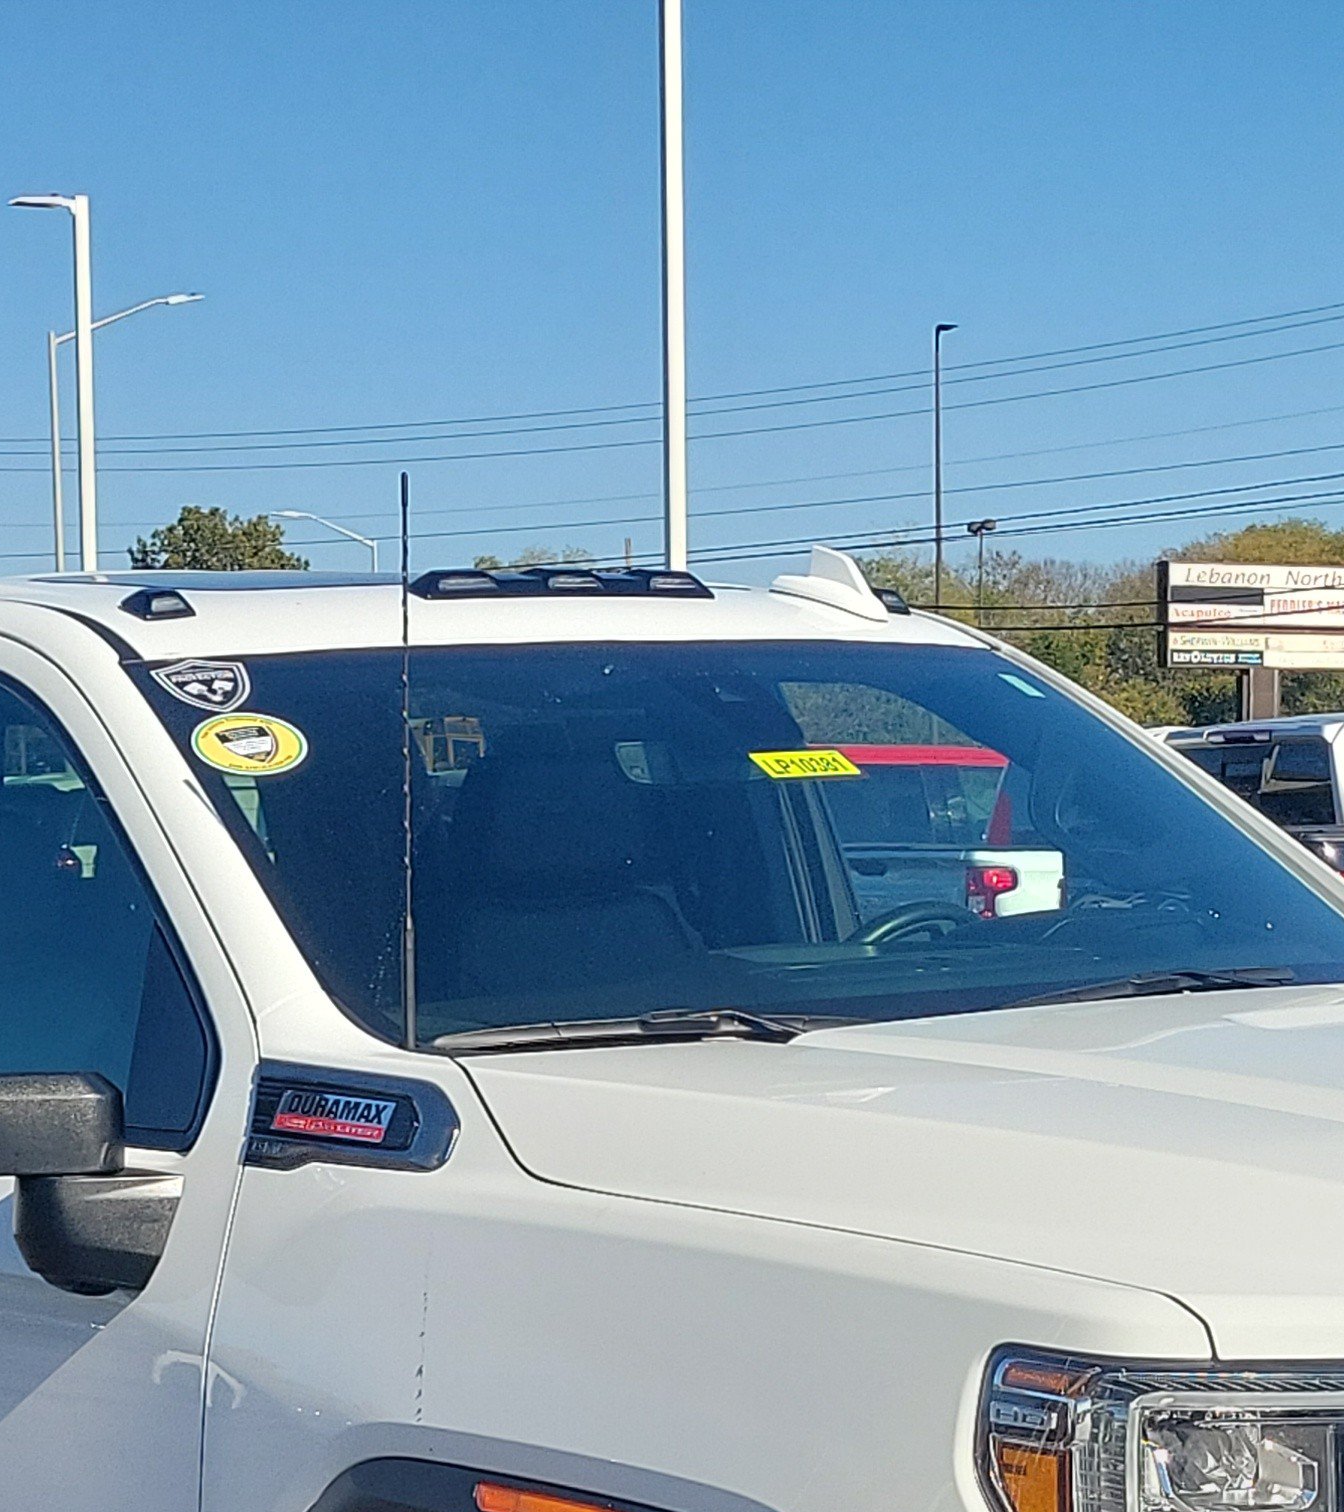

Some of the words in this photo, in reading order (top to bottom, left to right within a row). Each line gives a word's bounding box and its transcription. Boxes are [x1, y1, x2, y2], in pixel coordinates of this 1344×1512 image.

[1184, 567, 1271, 586] Lebanon
[1285, 570, 1343, 587] North
[288, 1093, 388, 1125] DURAMAX
